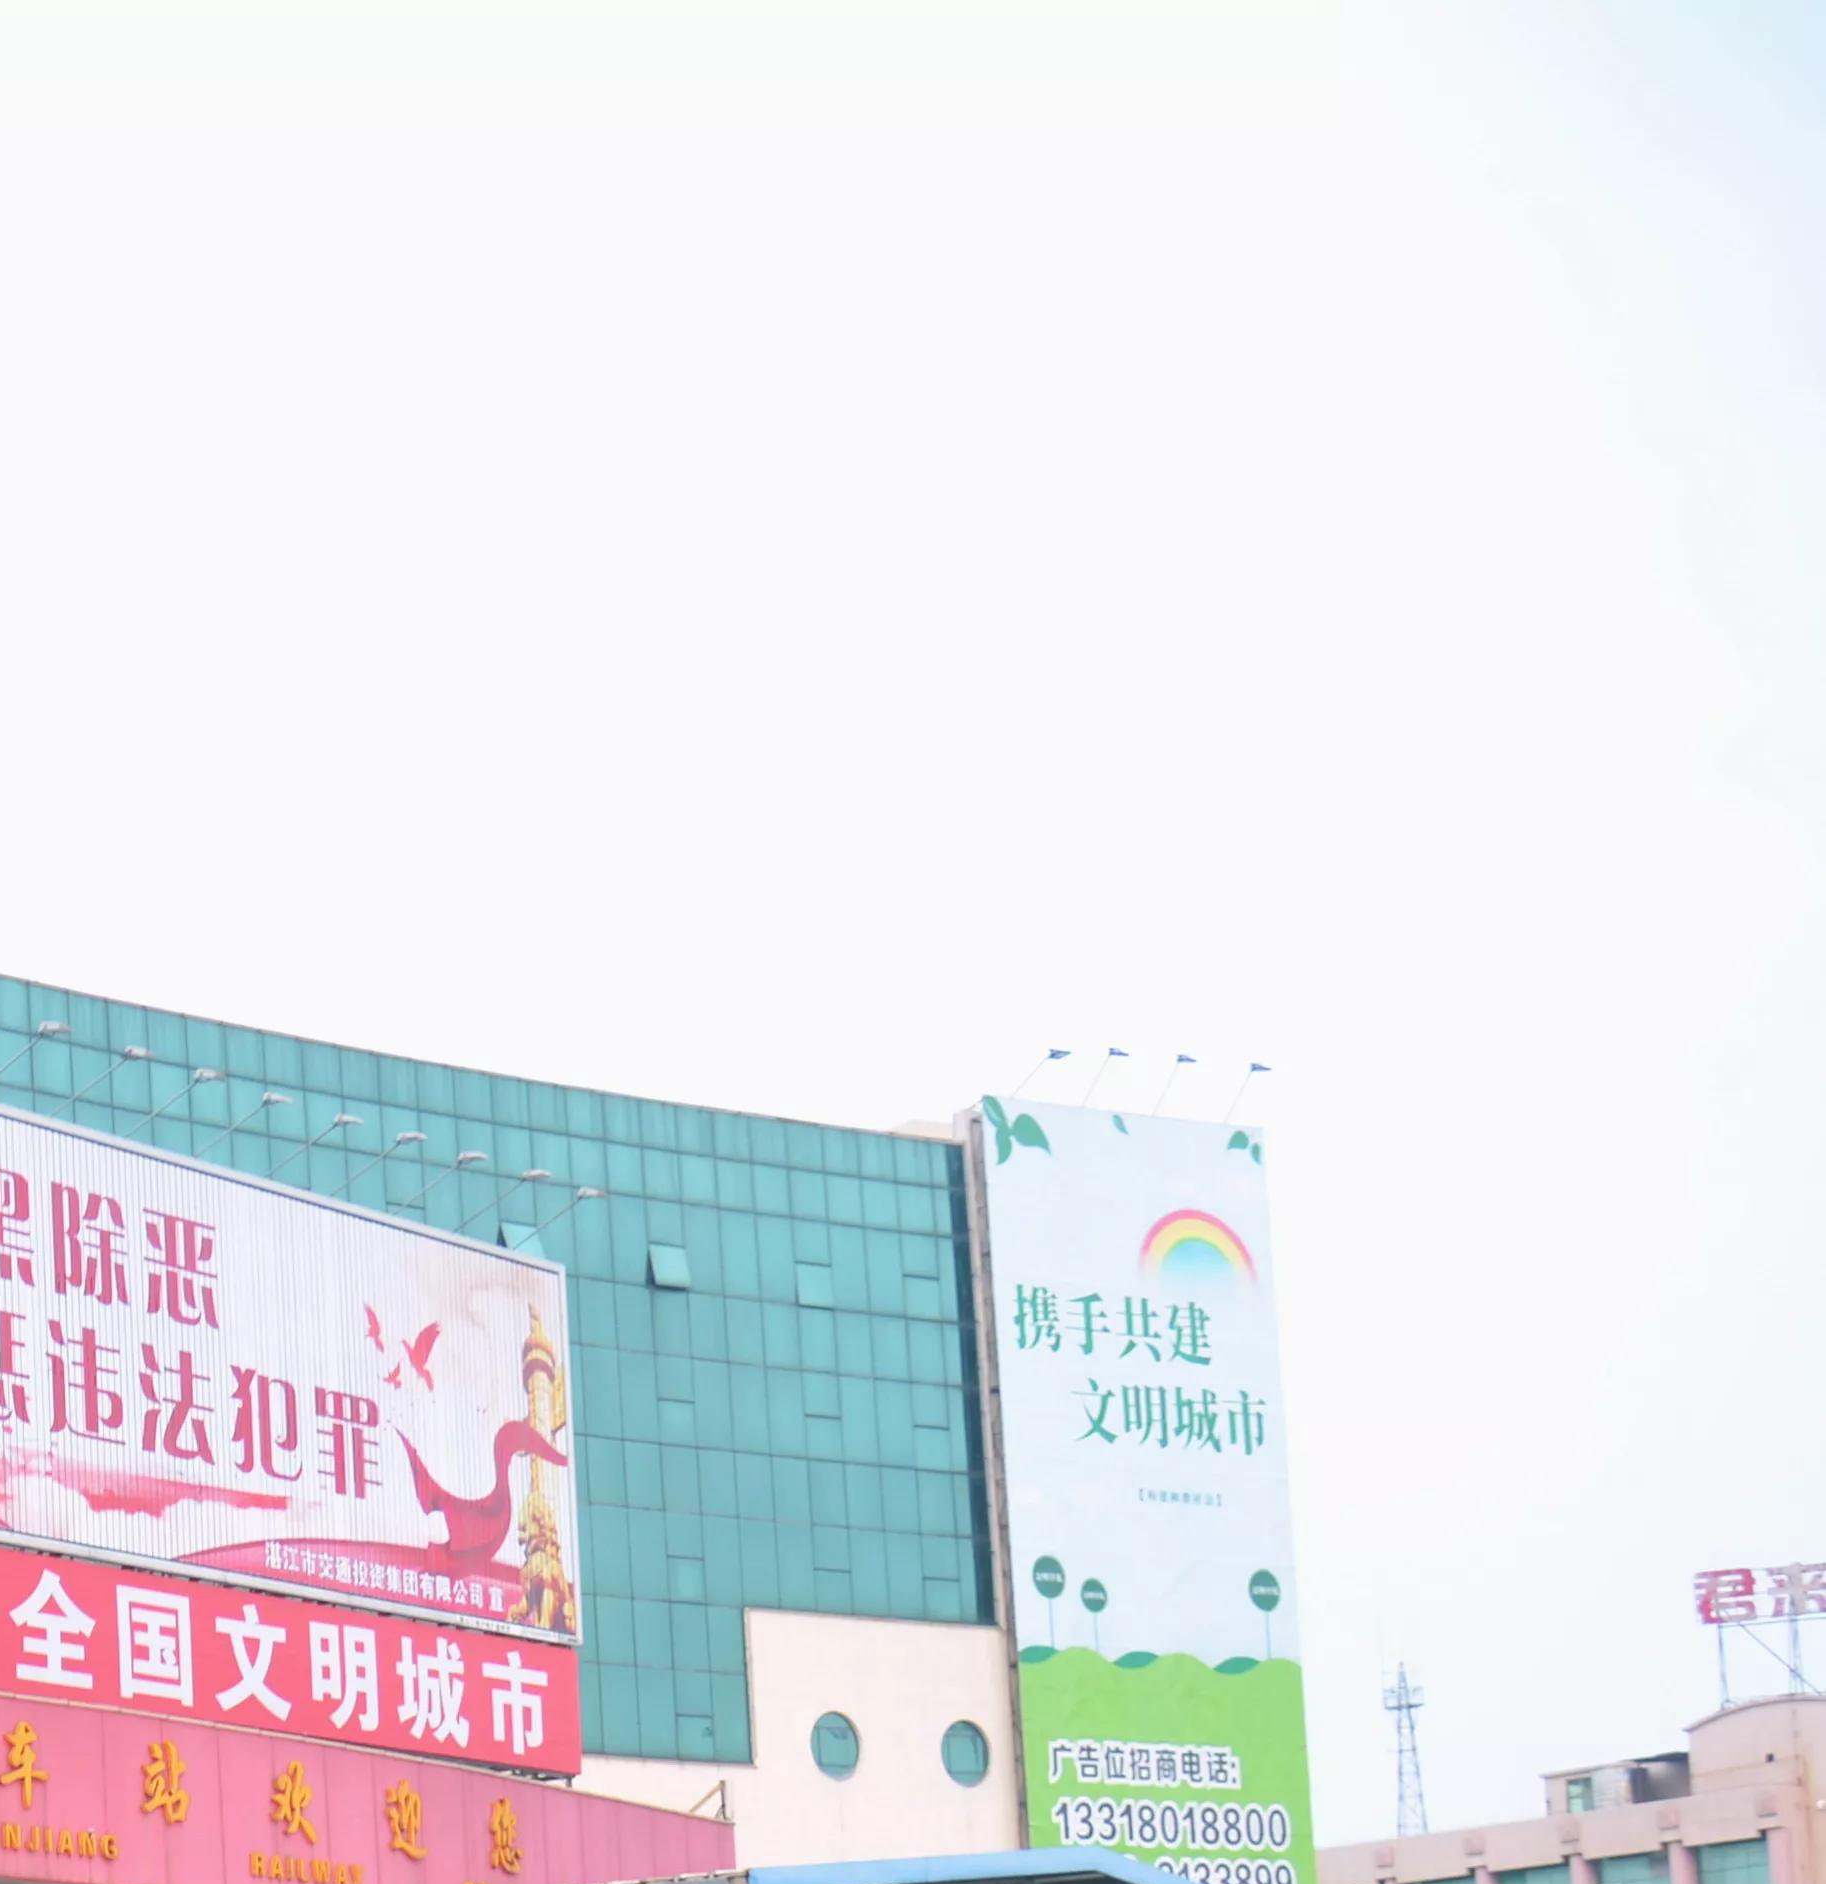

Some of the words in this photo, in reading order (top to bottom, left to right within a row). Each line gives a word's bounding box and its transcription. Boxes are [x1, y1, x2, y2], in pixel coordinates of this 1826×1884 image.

[1012, 1284, 1213, 1366] 携手共建
[1070, 1377, 1267, 1457] 文明城市
[264, 1540, 484, 1611] 湛江市交通投资集团有限公司
[1055, 1801, 1288, 1847] 13318018800
